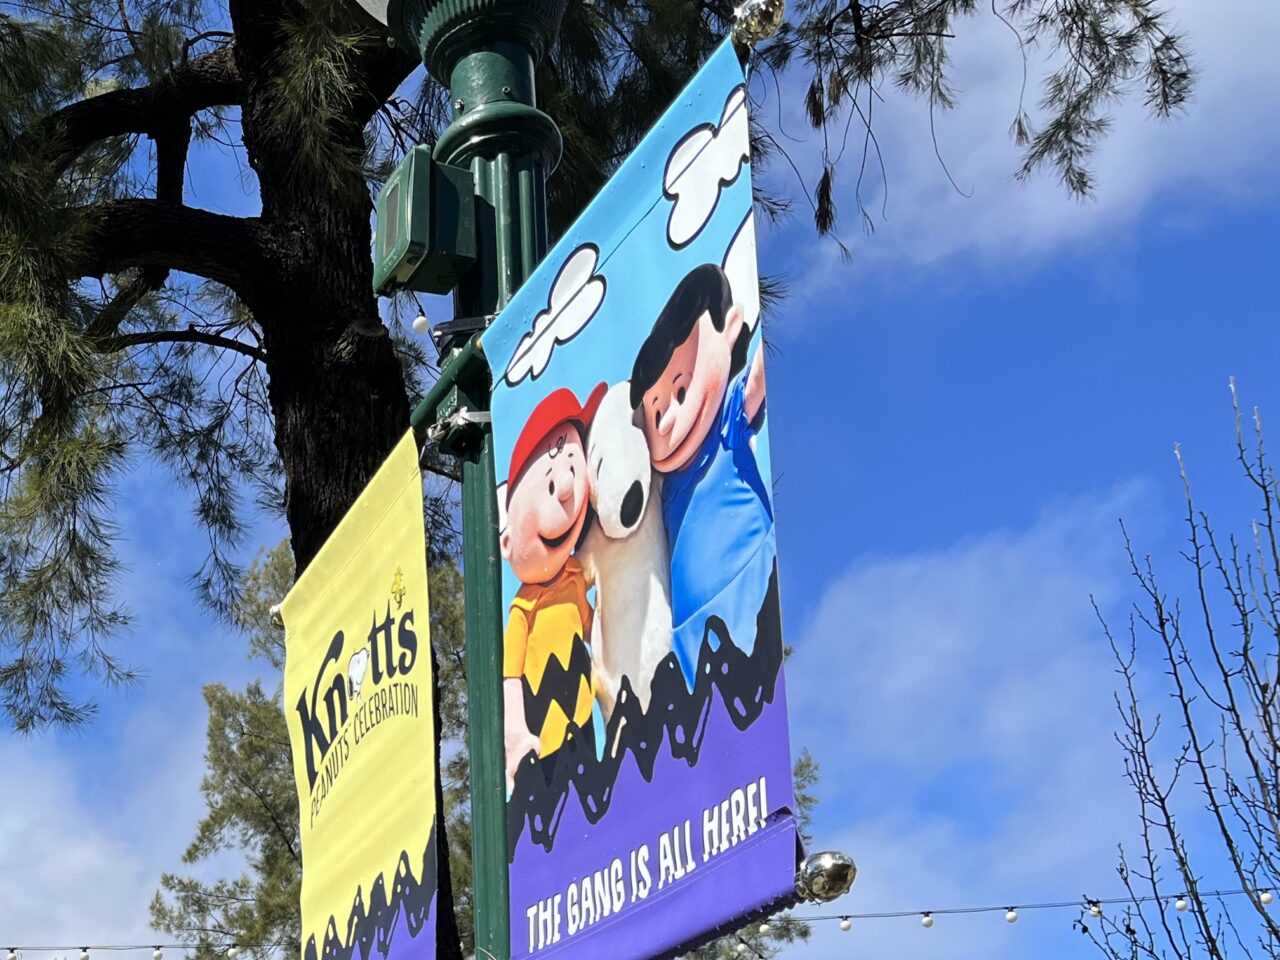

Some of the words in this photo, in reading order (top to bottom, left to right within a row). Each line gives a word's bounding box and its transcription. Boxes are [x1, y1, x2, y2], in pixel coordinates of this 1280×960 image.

[310, 727, 350, 828] PEANUTS
[354, 683, 418, 745] CELEBRATION
[526, 893, 561, 953] THE
[567, 857, 625, 936] GANG
[630, 844, 652, 903] IS
[658, 820, 696, 890] ALL
[702, 777, 768, 862] HERE!
